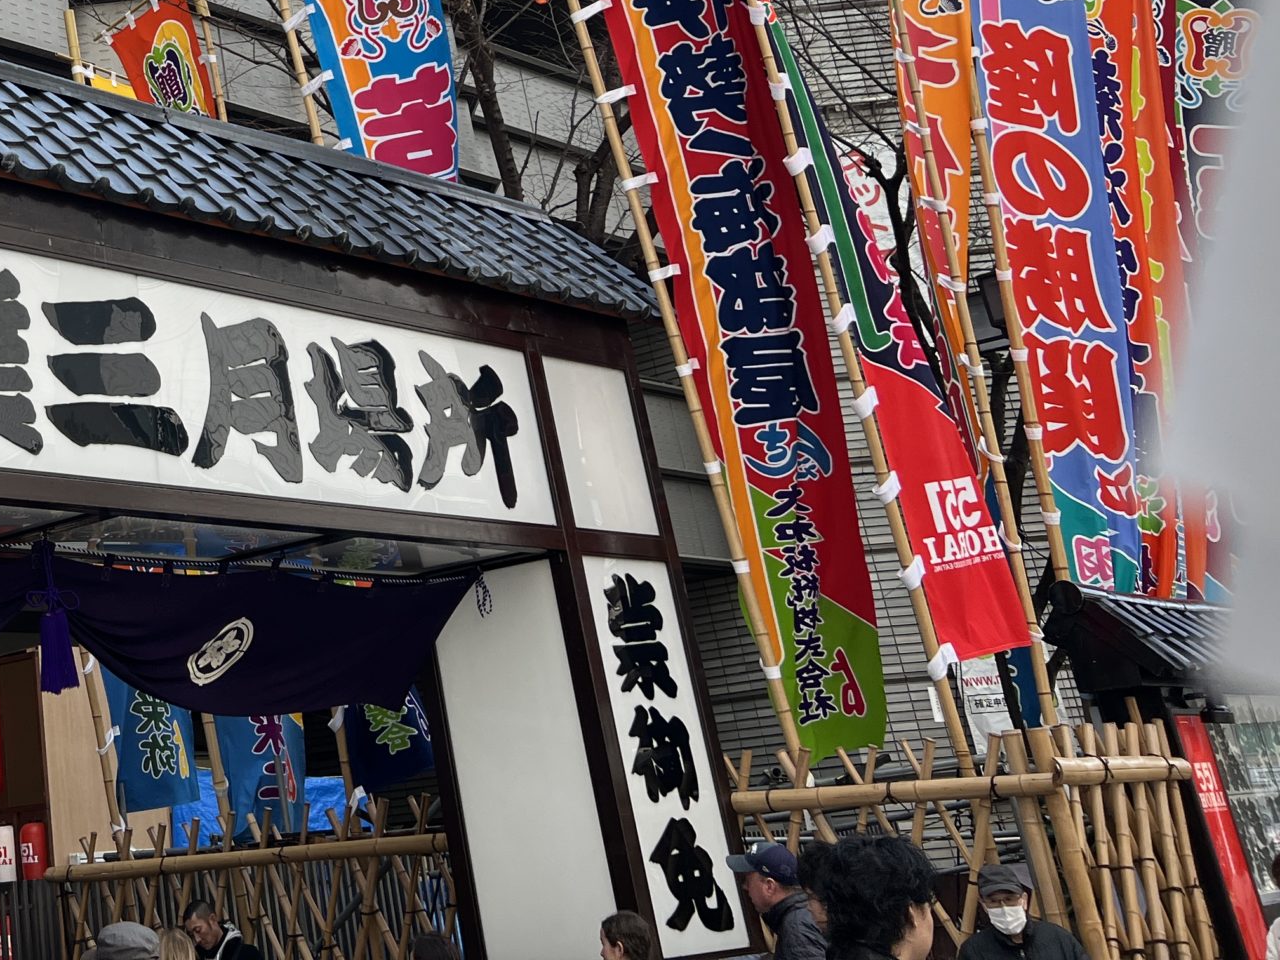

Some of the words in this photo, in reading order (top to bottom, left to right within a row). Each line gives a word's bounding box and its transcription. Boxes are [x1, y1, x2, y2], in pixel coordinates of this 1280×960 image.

[604, 572, 734, 931] 蒙御免
[1194, 762, 1218, 792] 551
